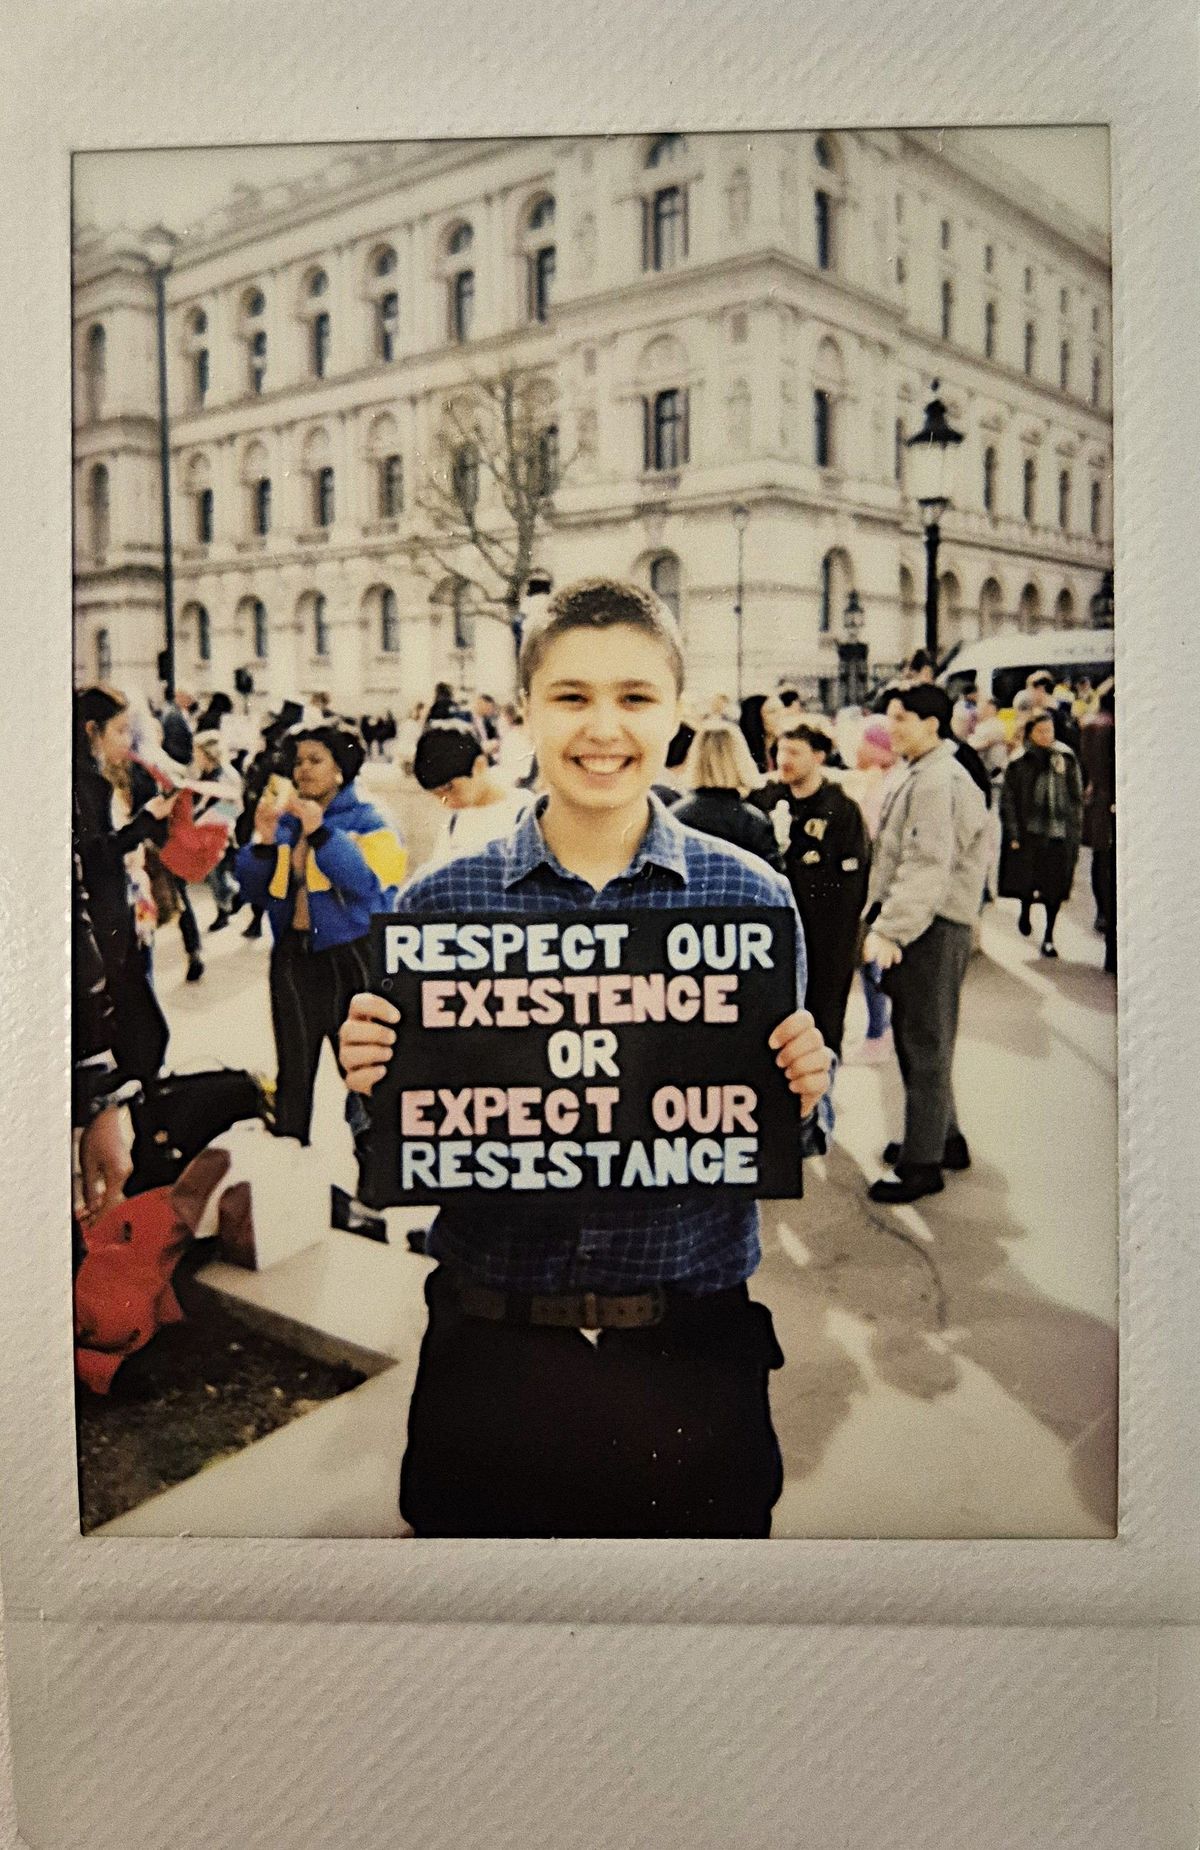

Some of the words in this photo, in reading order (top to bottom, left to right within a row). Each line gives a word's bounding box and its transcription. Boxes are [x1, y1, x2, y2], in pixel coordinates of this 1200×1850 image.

[384, 923, 630, 974] RESPECT
[666, 922, 775, 971] OUR
[421, 973, 739, 1028] EXISTENCE
[547, 1029, 620, 1079] OR
[401, 1086, 620, 1137] EXPECT
[652, 1084, 759, 1134] OUR
[402, 1136, 759, 1190] RESISTANCE
